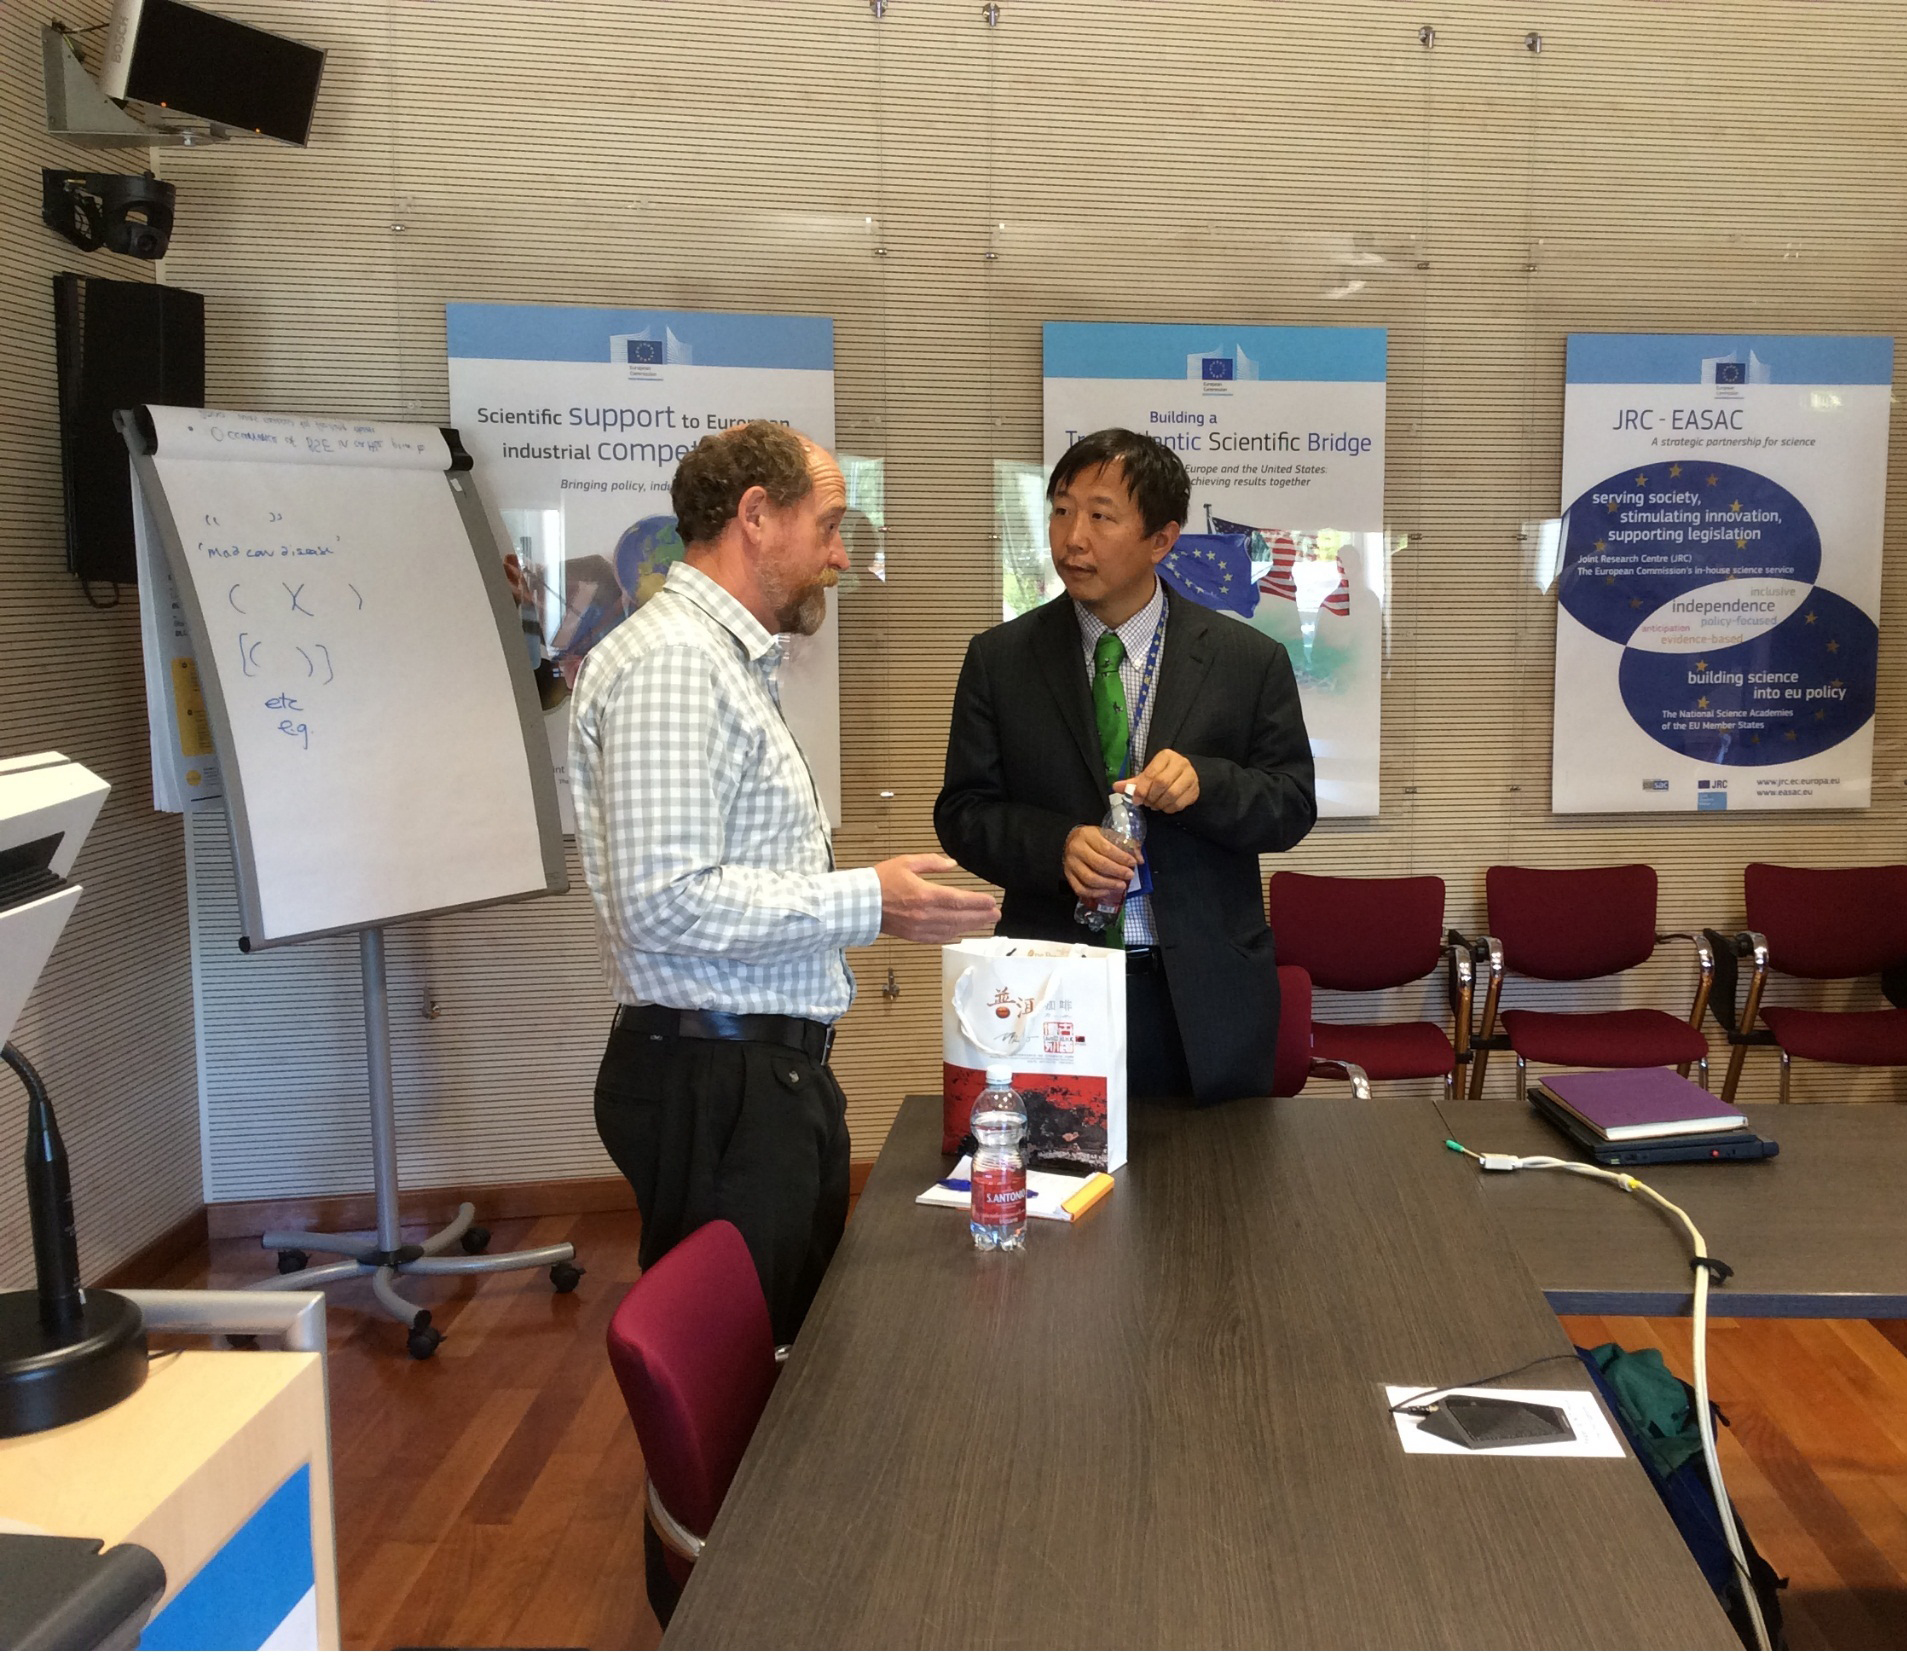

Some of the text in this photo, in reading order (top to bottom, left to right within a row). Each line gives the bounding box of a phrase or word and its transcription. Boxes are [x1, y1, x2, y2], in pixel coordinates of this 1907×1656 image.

[111, 16, 129, 63] BOSCH
[477, 407, 563, 425] Scientific
[569, 406, 676, 432] support
[681, 414, 700, 429] to
[1150, 411, 1218, 426] Building a
[1612, 409, 1654, 430] JRC
[1672, 409, 1744, 430] EASAC
[1208, 431, 1301, 451] Scientific
[1308, 432, 1372, 456] Bridge
[1651, 436, 1816, 448] A strategic partnership for science
[502, 443, 591, 460] industrial
[1185, 464, 1218, 475] Europe
[1221, 463, 1239, 474] and
[1242, 463, 1258, 474] the
[1261, 464, 1292, 474] United
[560, 479, 608, 492] Bringing
[611, 480, 647, 493] policy,
[1233, 477, 1267, 486] results
[1269, 477, 1311, 488] together
[1592, 491, 1702, 507] serving society,
[1620, 509, 1782, 526] stimulating innovation,
[1608, 527, 1761, 543] supporting legislation
[1577, 554, 1693, 564] Joint Research Centre (JRC)
[1577, 566, 1795, 577] The European Commission's in-house science service
[1750, 587, 1796, 597] inclusive
[1672, 598, 1776, 615] independence
[1641, 624, 1691, 633] anticipation
[1700, 615, 1778, 628] policy-focused
[1660, 634, 1744, 645] evidence-based
[1687, 670, 1799, 687] building science
[1753, 686, 1847, 701] into eu policy
[1662, 709, 1794, 718] The National Science Academies
[1661, 720, 1765, 730] of the EU Member States
[1711, 779, 1728, 789] JRC
